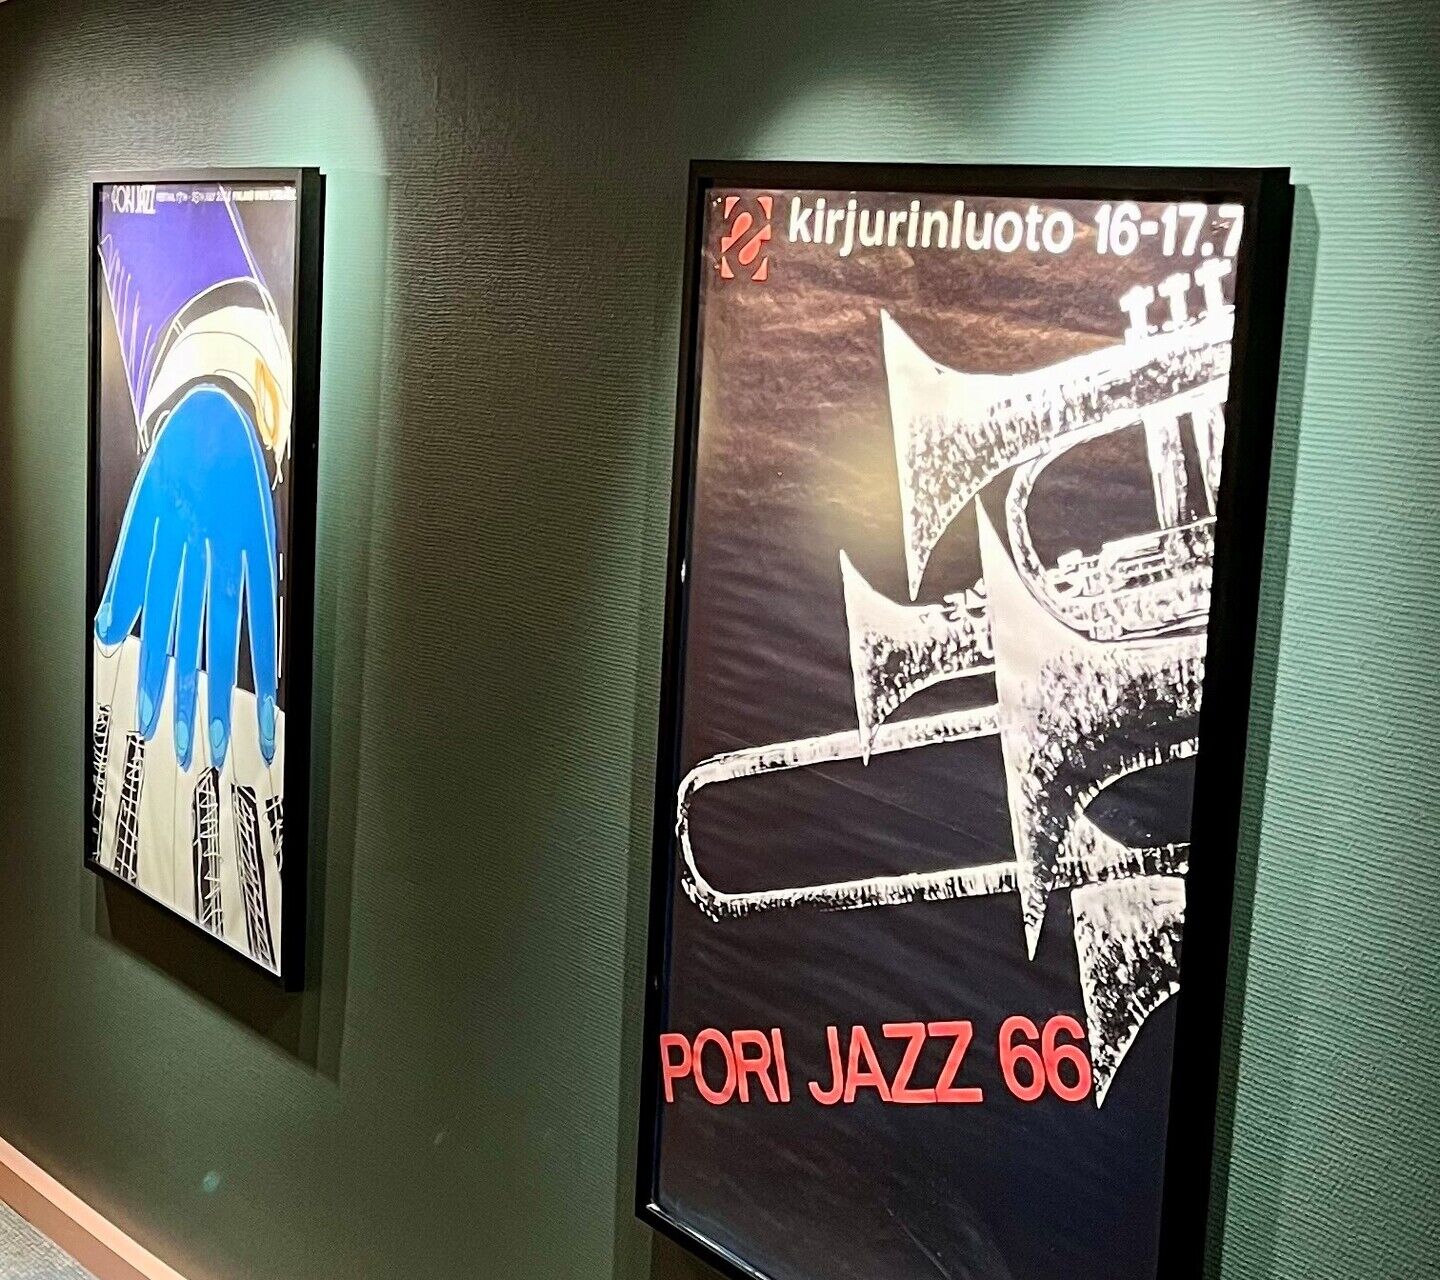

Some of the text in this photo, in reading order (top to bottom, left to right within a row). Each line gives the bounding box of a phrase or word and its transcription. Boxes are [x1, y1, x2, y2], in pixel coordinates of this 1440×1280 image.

[789, 197, 1075, 257] kirjurinluoto
[659, 1015, 1092, 1105] PORI JAZZ 66
